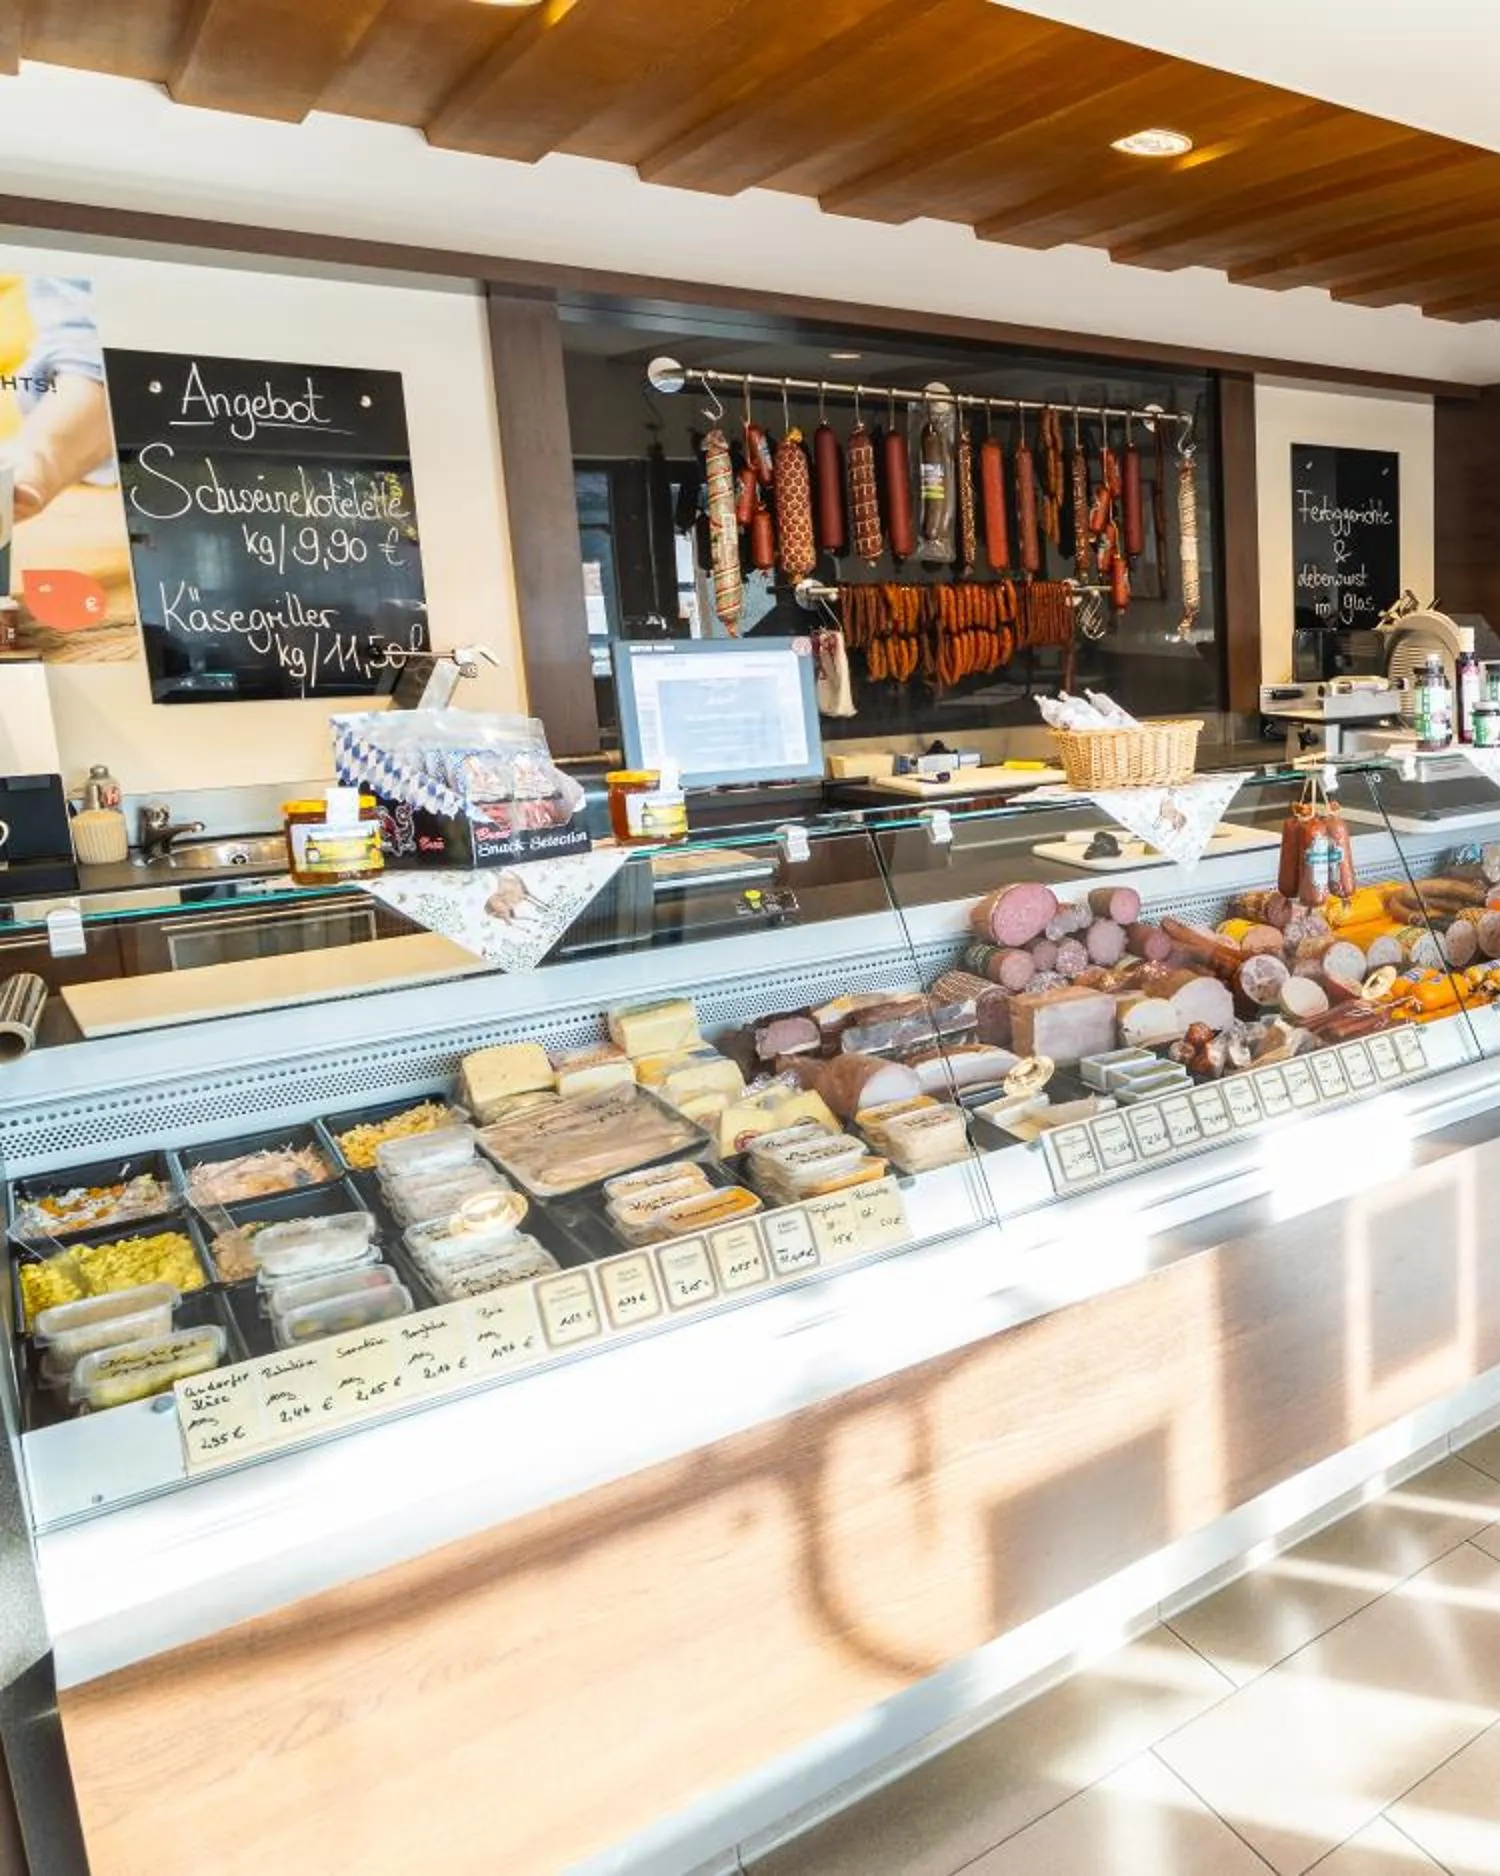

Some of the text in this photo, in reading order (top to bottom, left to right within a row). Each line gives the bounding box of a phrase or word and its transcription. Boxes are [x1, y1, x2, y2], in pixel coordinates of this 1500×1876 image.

[181, 363, 332, 441] Angebot
[131, 443, 411, 520] Schweinekotelette
[242, 525, 405, 575] kg/9,90 €
[1333, 540, 1352, 563] &
[159, 581, 340, 653] Käsegriller
[477, 838, 526, 857] Snack
[529, 830, 588, 850] Selection
